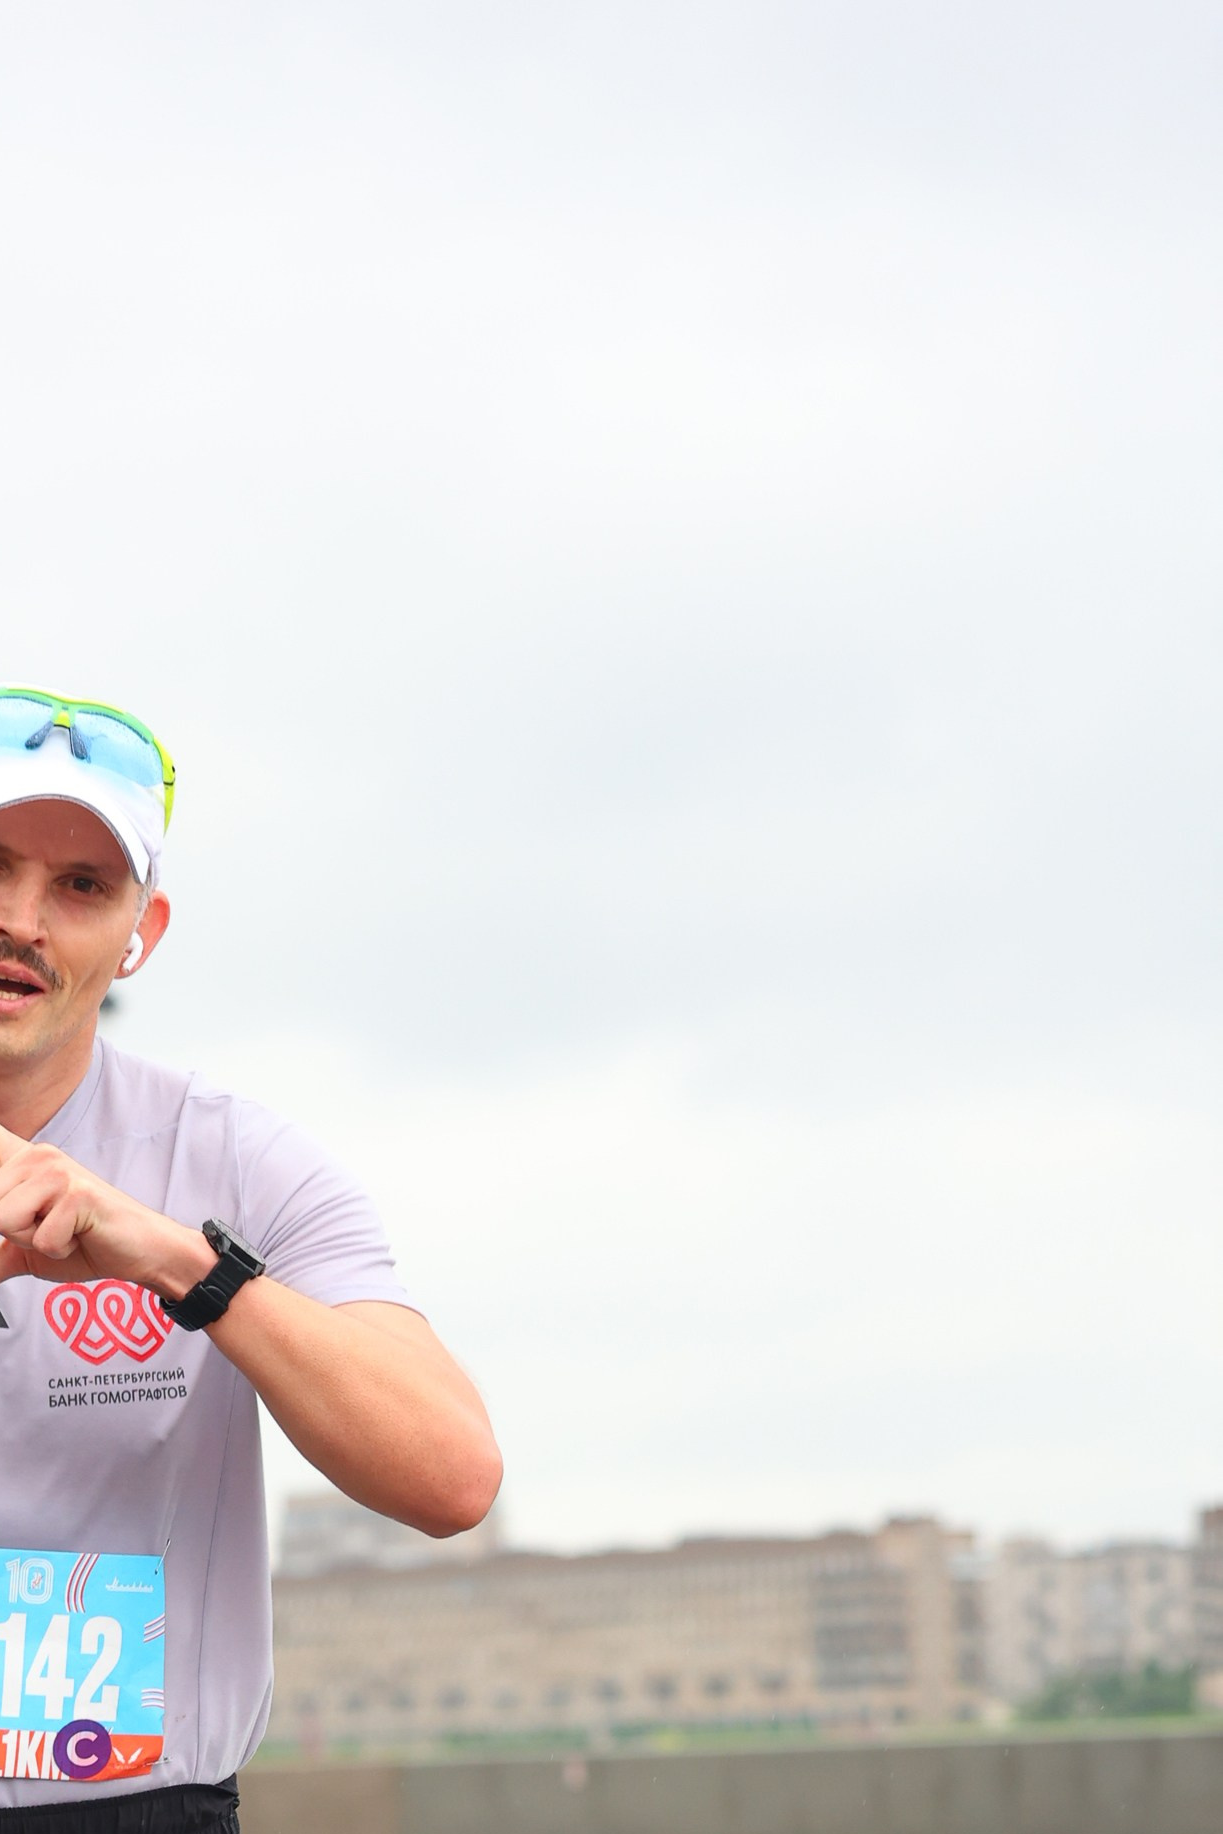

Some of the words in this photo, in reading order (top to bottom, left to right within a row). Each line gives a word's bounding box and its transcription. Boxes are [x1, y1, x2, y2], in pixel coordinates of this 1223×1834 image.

[48, 1367, 186, 1390] САНКТ-ПЕТЕРБУРГСКИЙ
[48, 1392, 88, 1408] БАНК
[91, 1385, 188, 1405] ГОМОГРАФТОВ
[5, 1557, 54, 1604] 10
